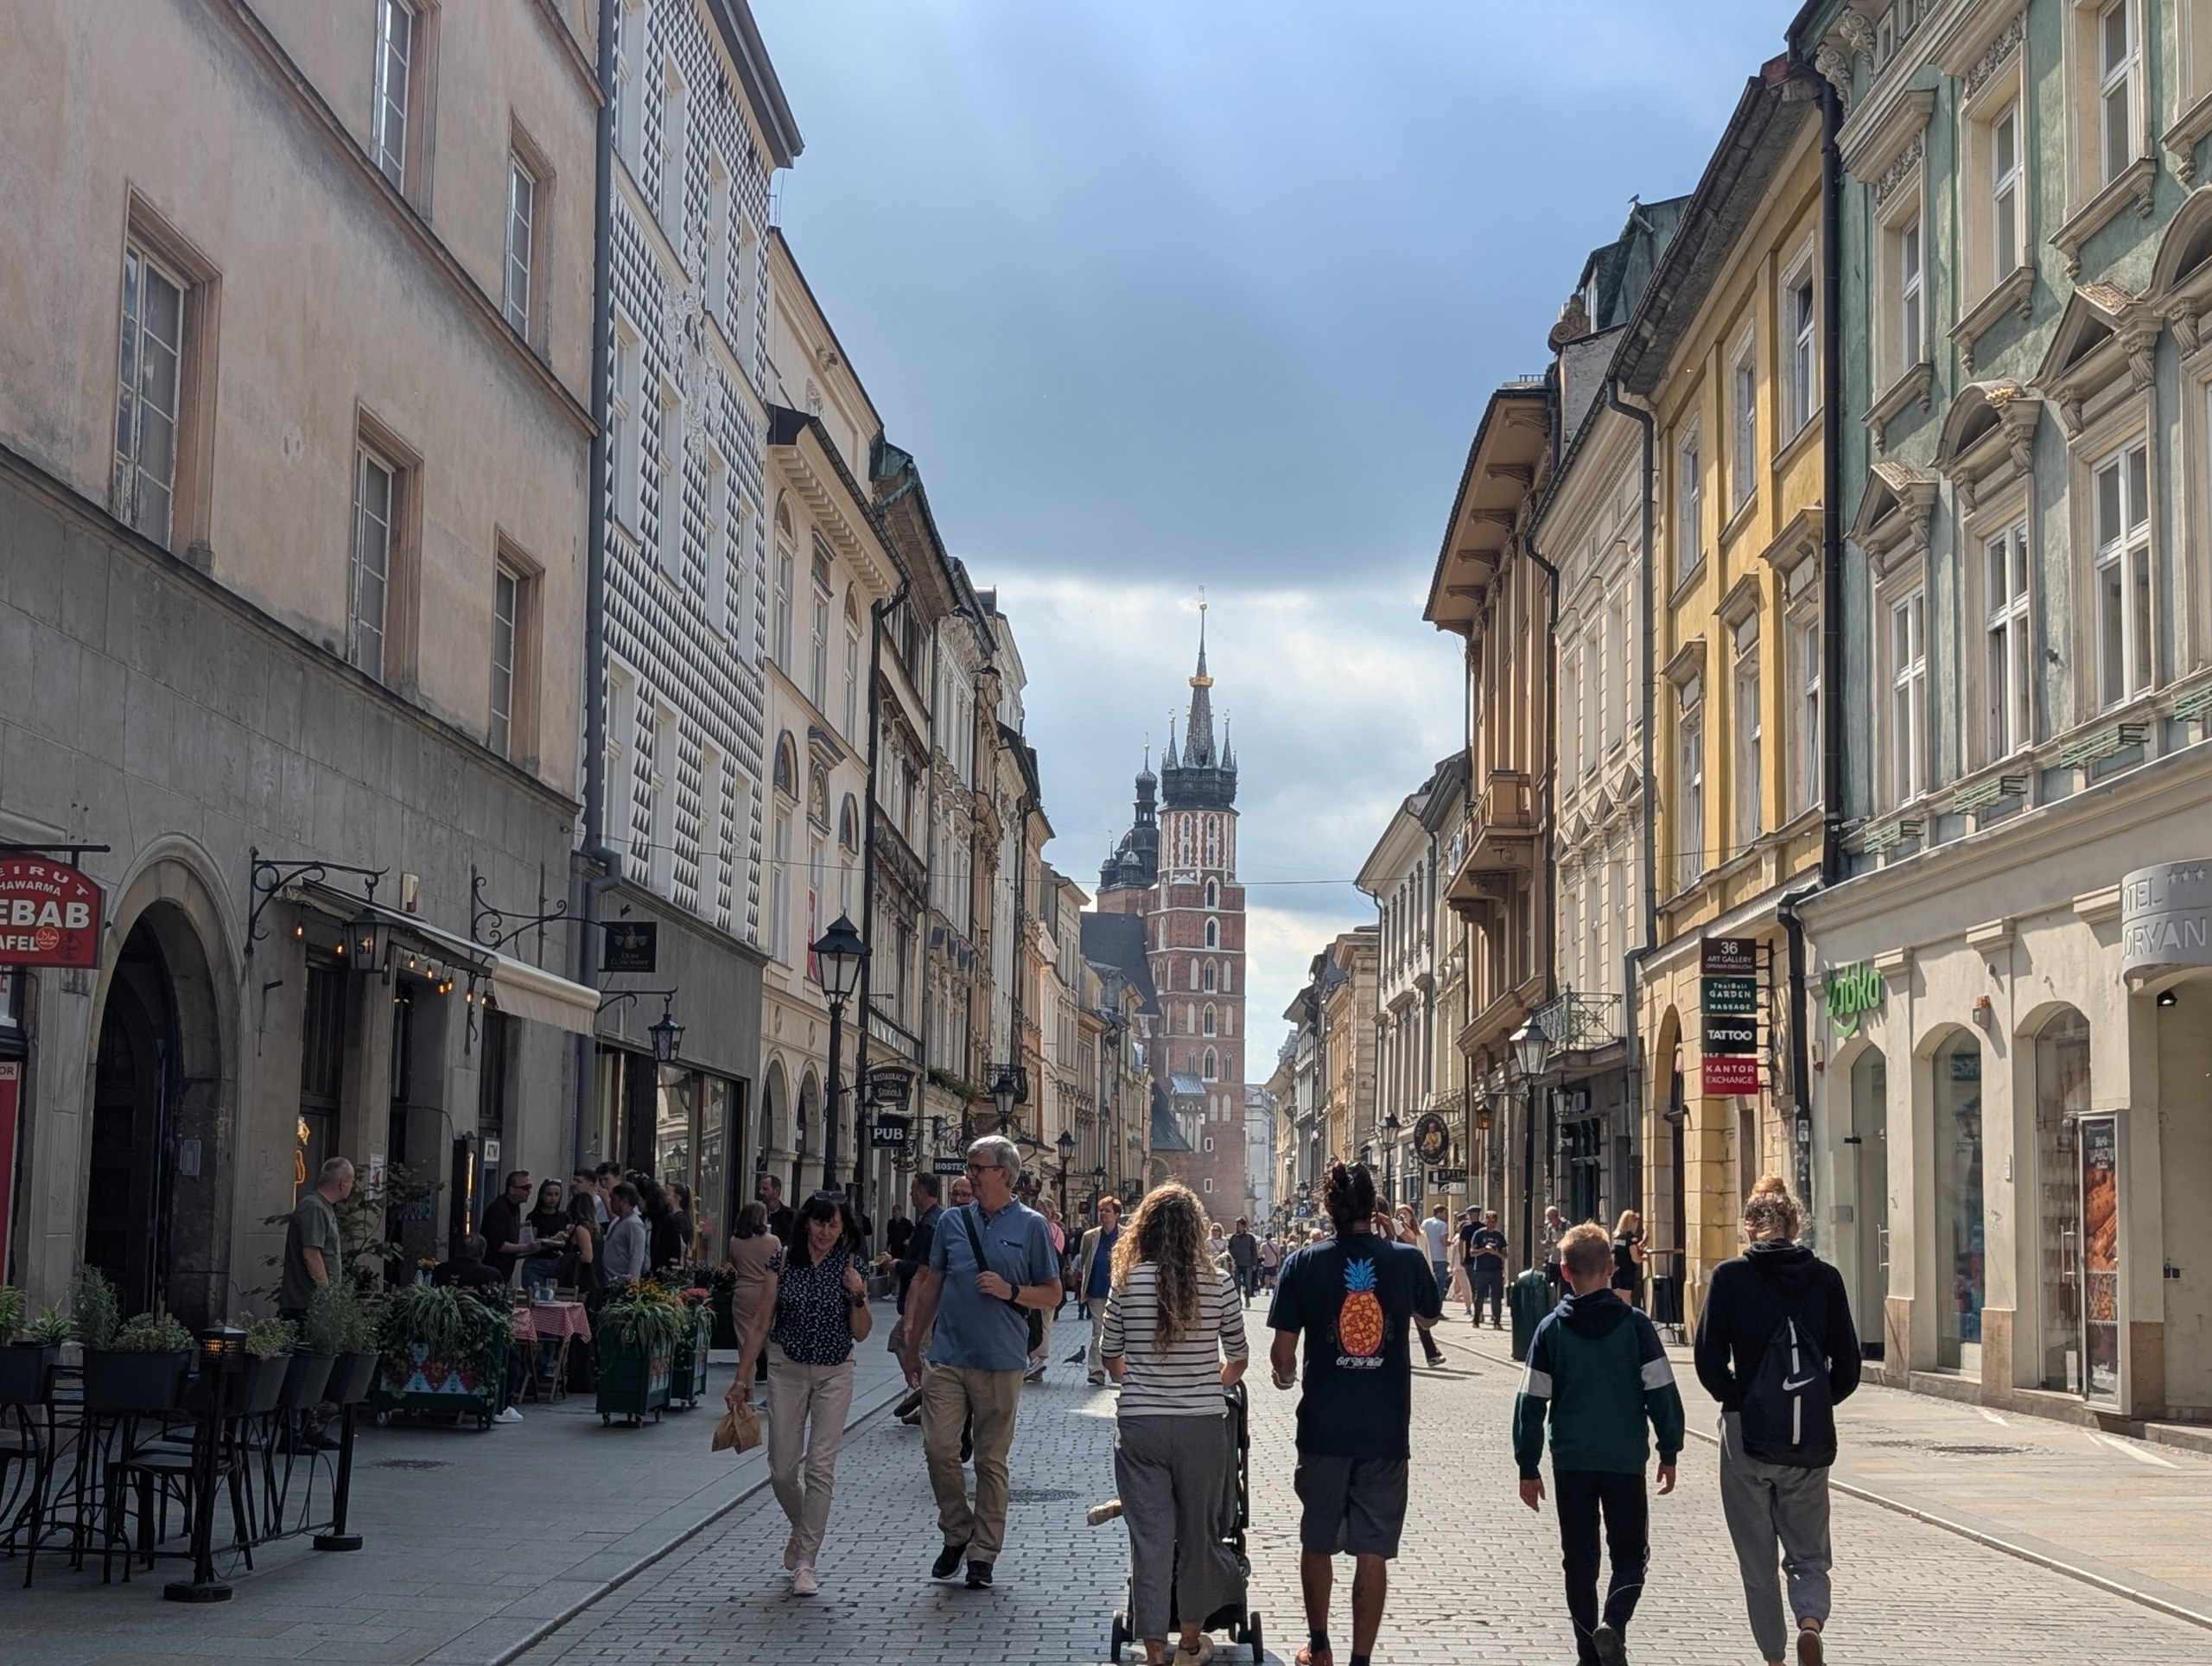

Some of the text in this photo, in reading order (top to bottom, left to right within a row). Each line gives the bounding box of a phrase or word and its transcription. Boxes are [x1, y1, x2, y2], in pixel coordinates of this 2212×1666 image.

[2122, 917, 2208, 962] ORYAN
[1720, 941, 1738, 955] 36
[1709, 990, 1751, 999] GARDEN
[1707, 1029, 1753, 1041] TATTOO
[1706, 1065, 1755, 1073] KANTOR
[1706, 1076, 1754, 1084] EXCHANGE
[873, 1128, 904, 1140] PUB
[935, 1162, 966, 1171] HOSTE
[1299, 1207, 1306, 1217] P
